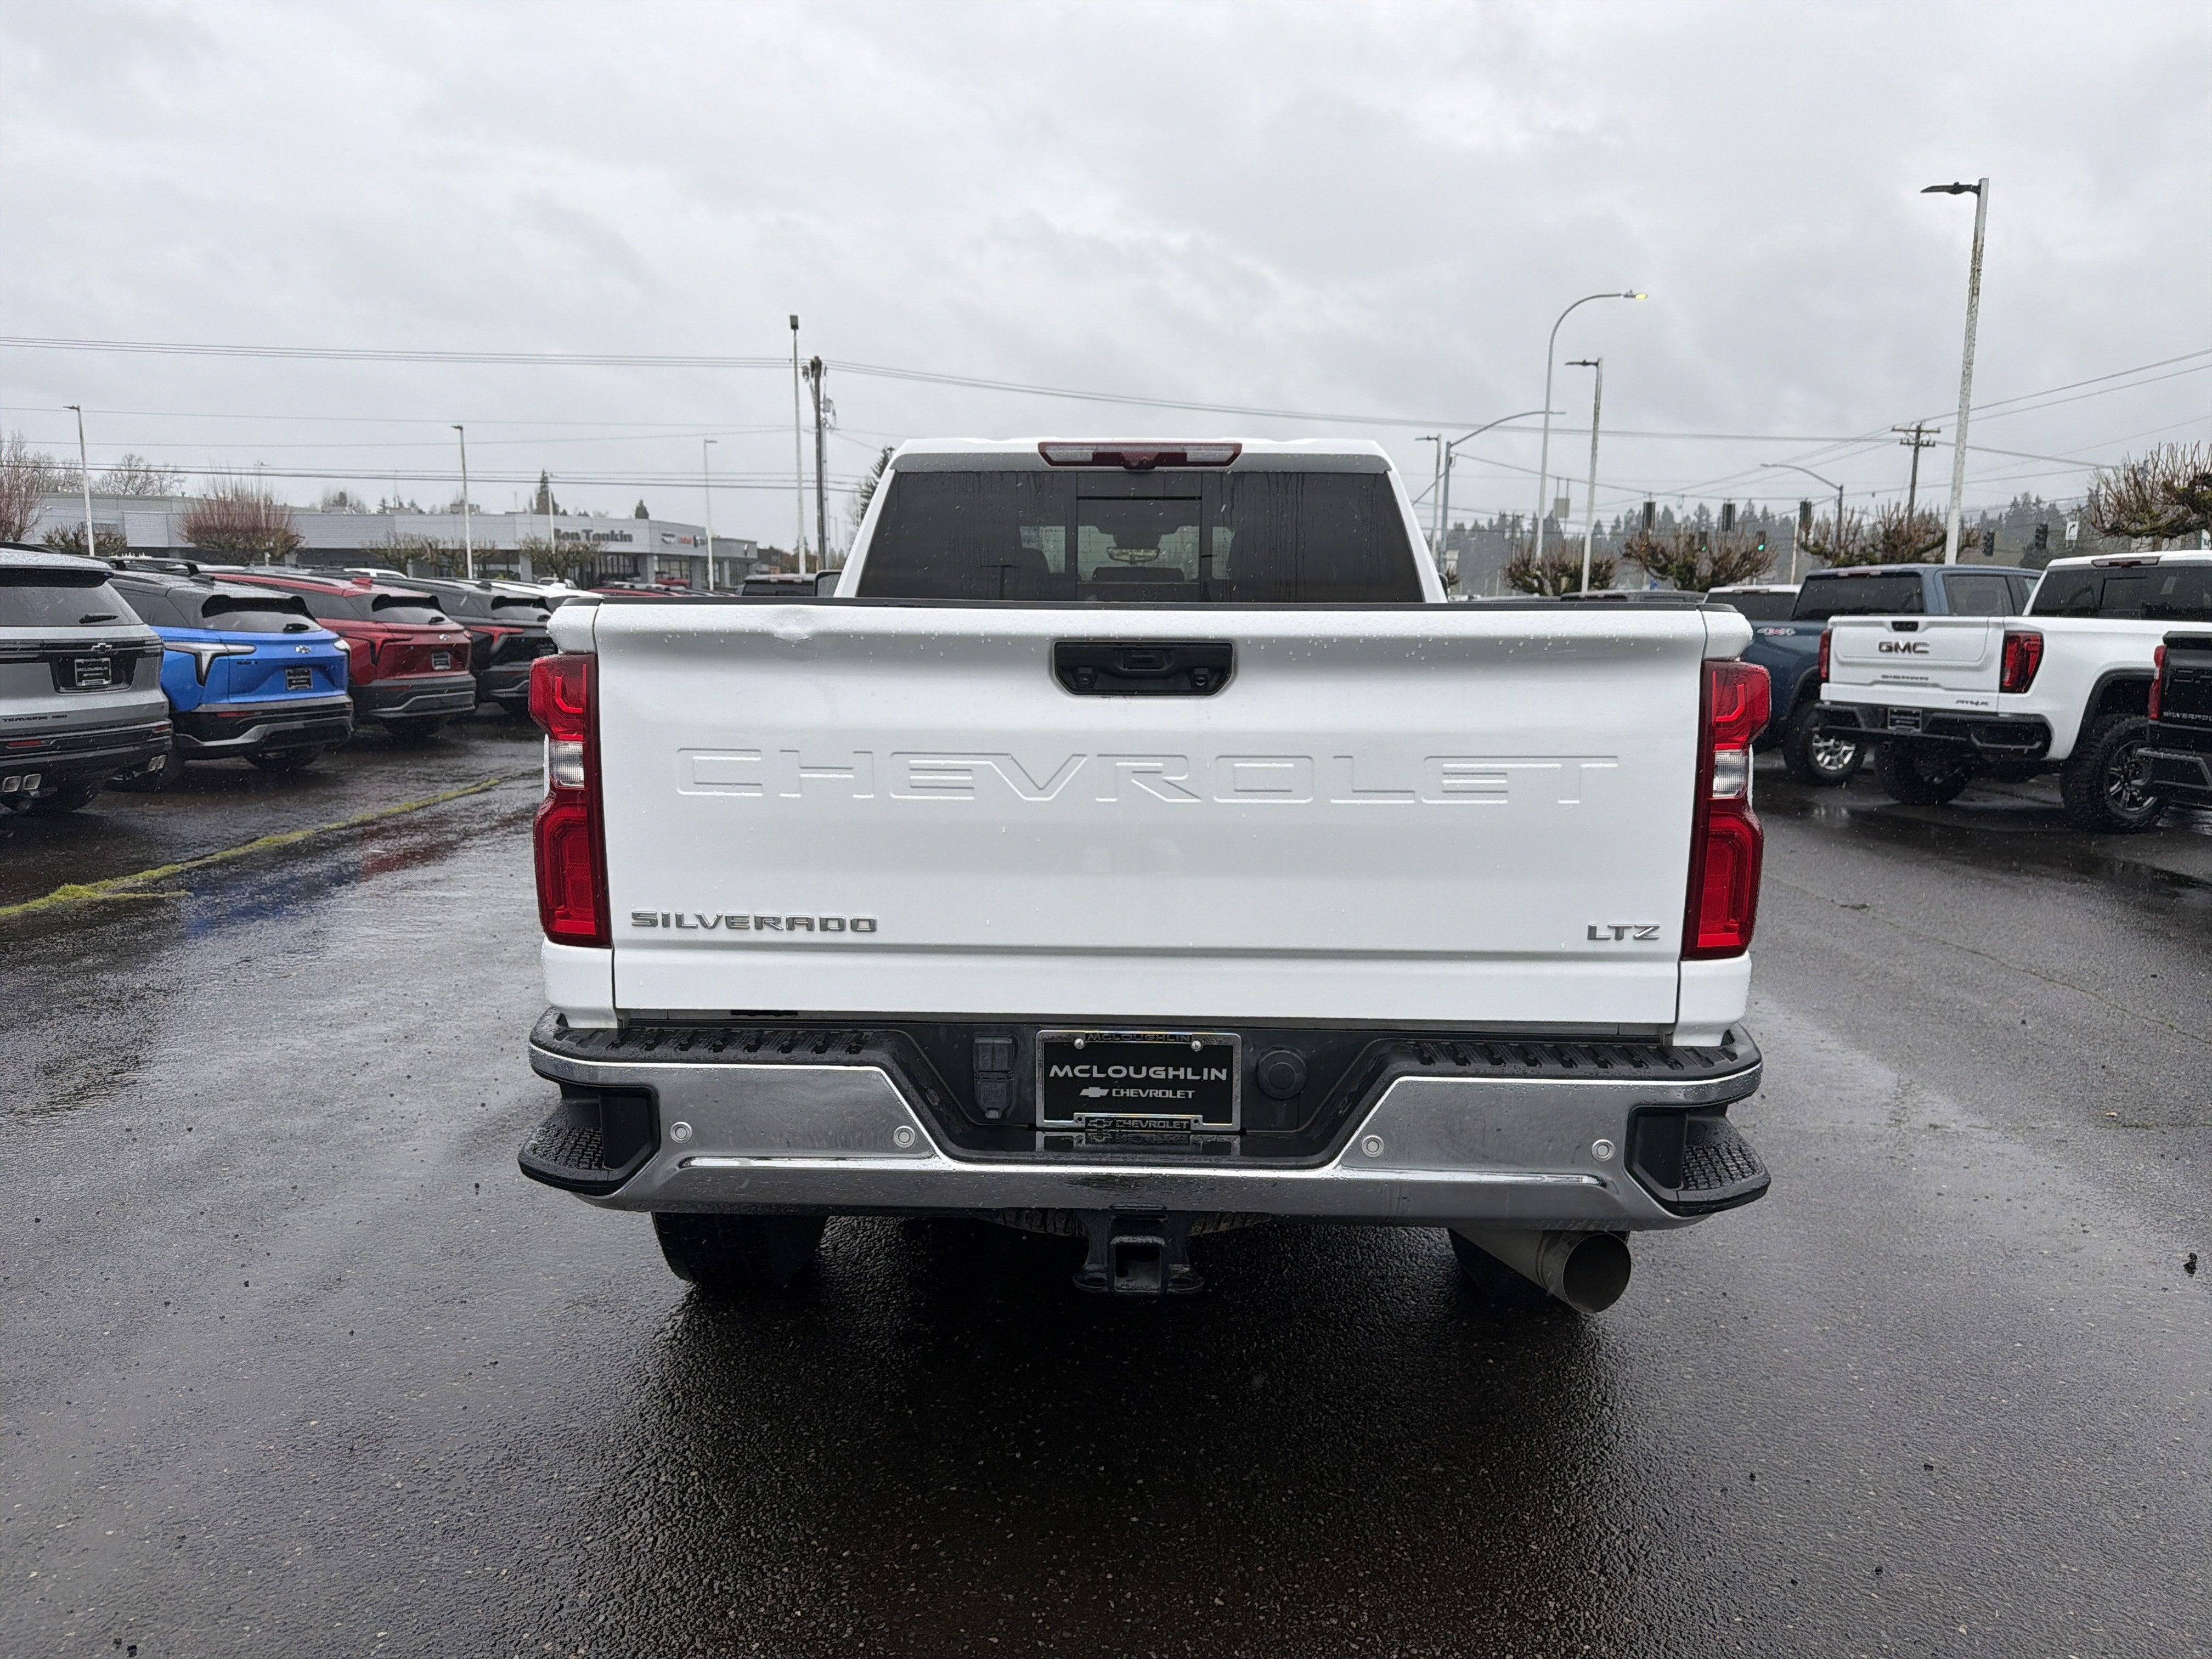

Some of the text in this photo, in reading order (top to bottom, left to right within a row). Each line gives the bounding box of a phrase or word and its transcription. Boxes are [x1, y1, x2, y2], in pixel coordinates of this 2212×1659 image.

[1878, 641, 1930, 653] GMC
[676, 748, 1618, 803] CHEVROLET
[631, 910, 877, 932] SILVERADO
[1587, 923, 1660, 940] LTZ
[1087, 1034, 1192, 1042] MCLOUGHLIN
[1049, 1065, 1227, 1081] MCLOUGHLIN
[1112, 1089, 1195, 1099] CHEVROLET
[1115, 1119, 1189, 1130] CHEVROLET
